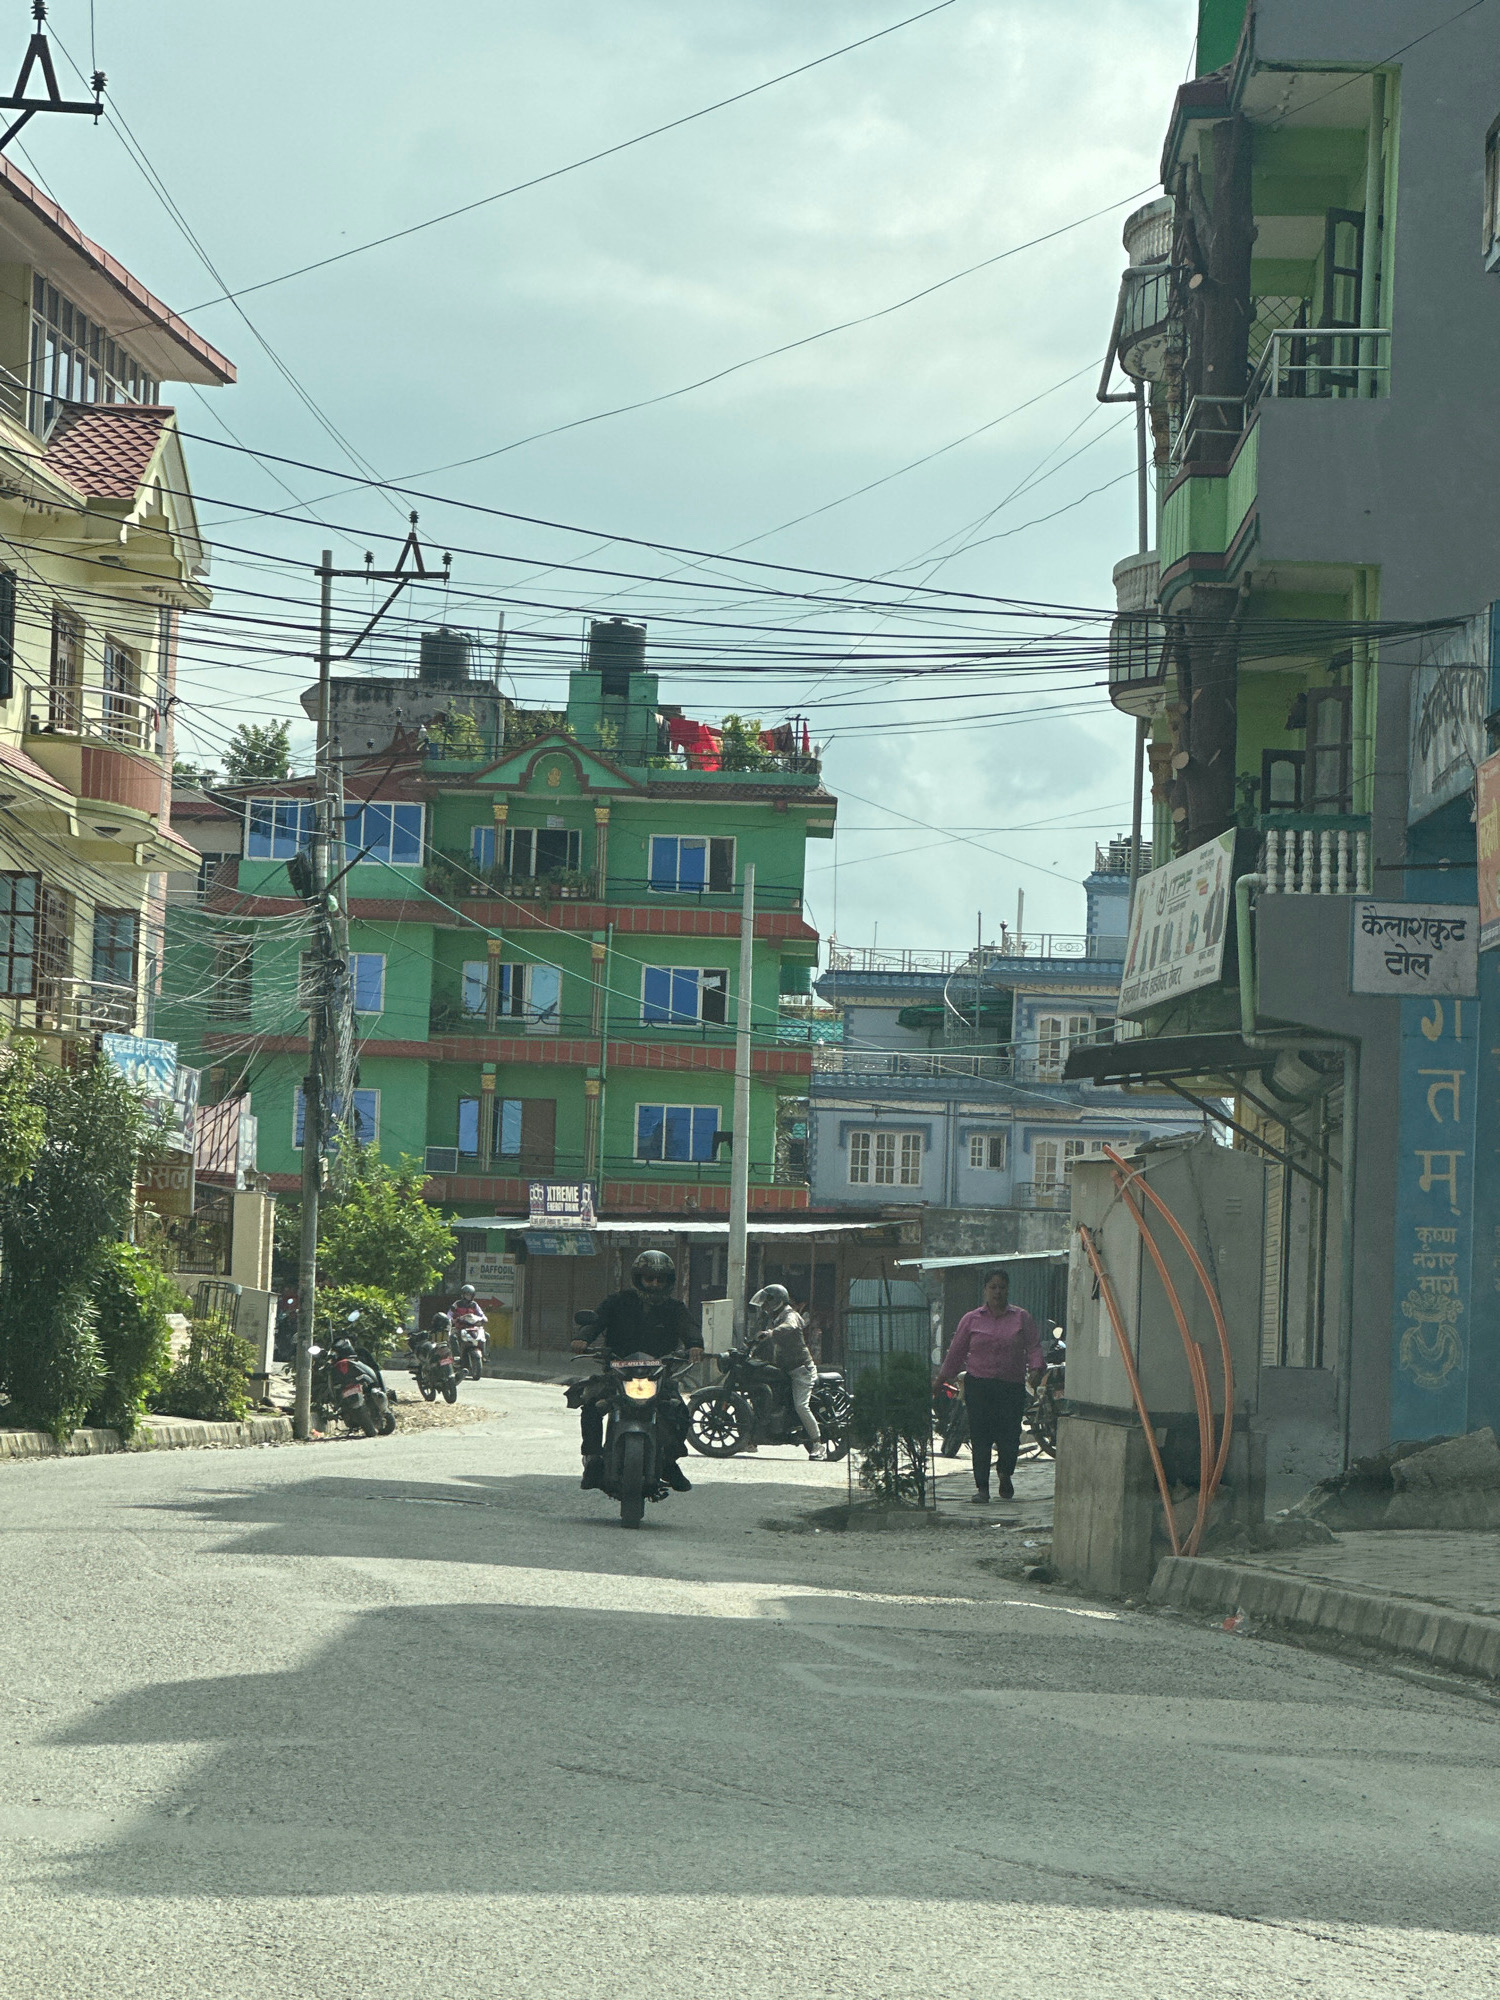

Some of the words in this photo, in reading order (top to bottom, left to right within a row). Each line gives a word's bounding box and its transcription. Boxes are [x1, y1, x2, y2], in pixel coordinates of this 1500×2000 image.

[1362, 905, 1467, 950] कैलाशकुट
[1384, 943, 1433, 980] टोल
[547, 1186, 579, 1202] XTREME
[547, 1202, 563, 1212] ENERGY
[1414, 1227, 1457, 1251] कृष्ण
[1413, 1252, 1458, 1268] नगर
[480, 1264, 514, 1275] DAFFODIL
